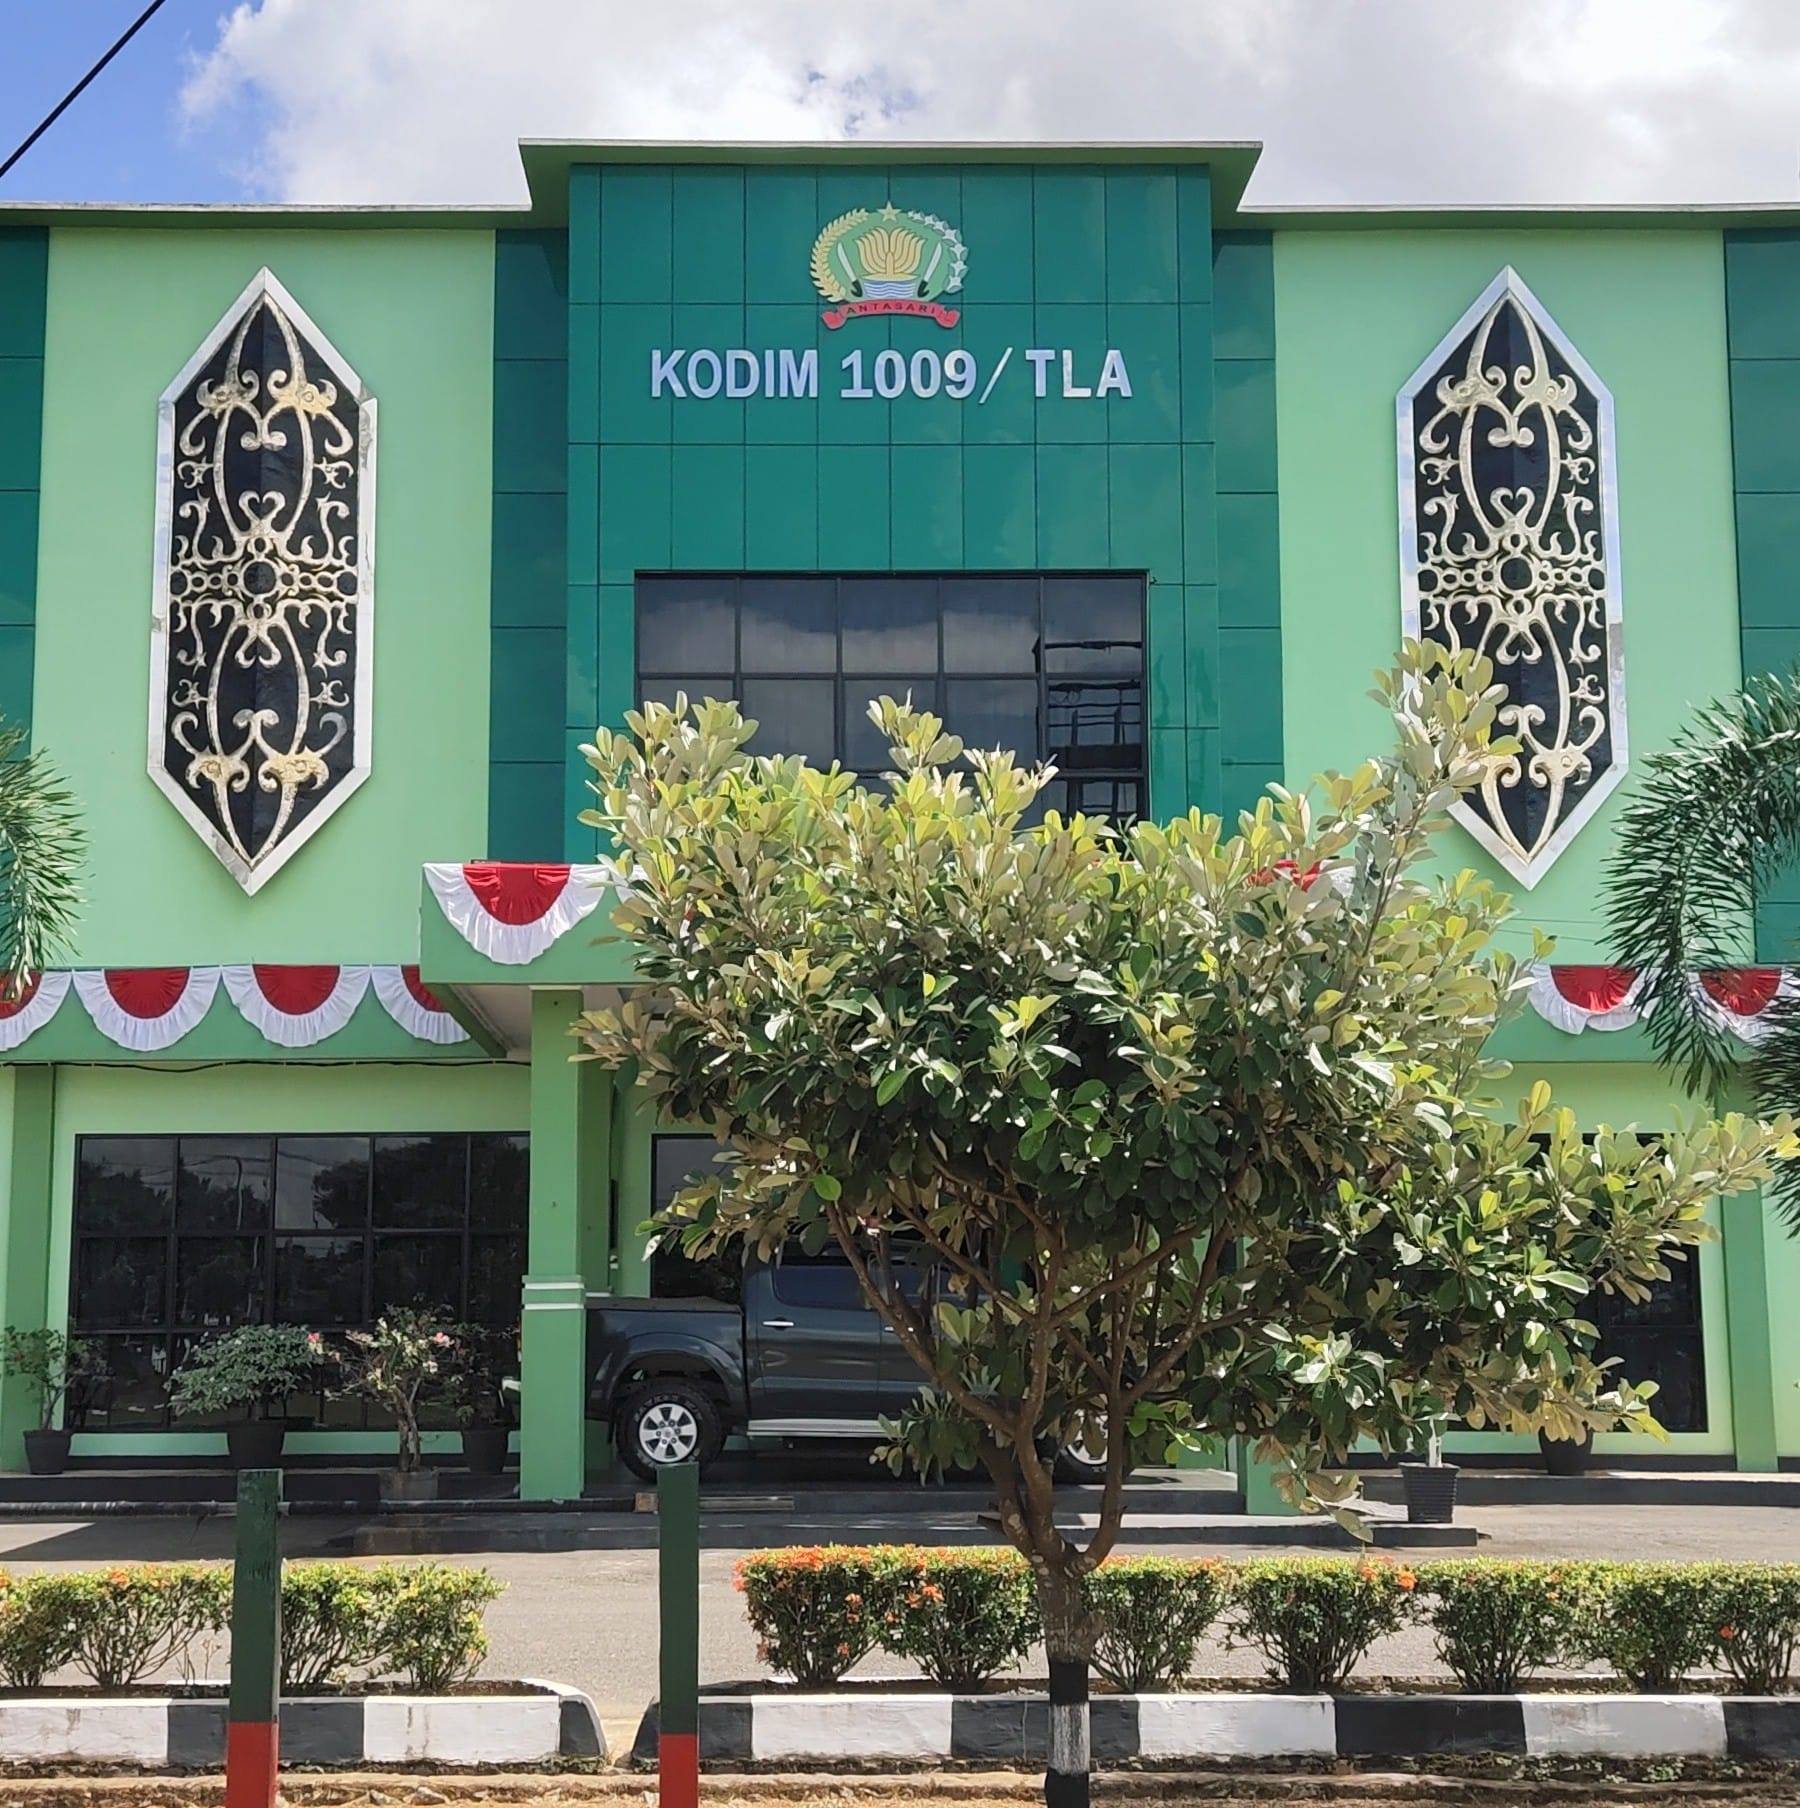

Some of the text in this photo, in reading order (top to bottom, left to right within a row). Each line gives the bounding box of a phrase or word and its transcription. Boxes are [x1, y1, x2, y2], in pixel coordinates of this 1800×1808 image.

[846, 302, 936, 315] ANTASARI
[651, 349, 818, 398] KODIM
[1025, 348, 1133, 398] TLA
